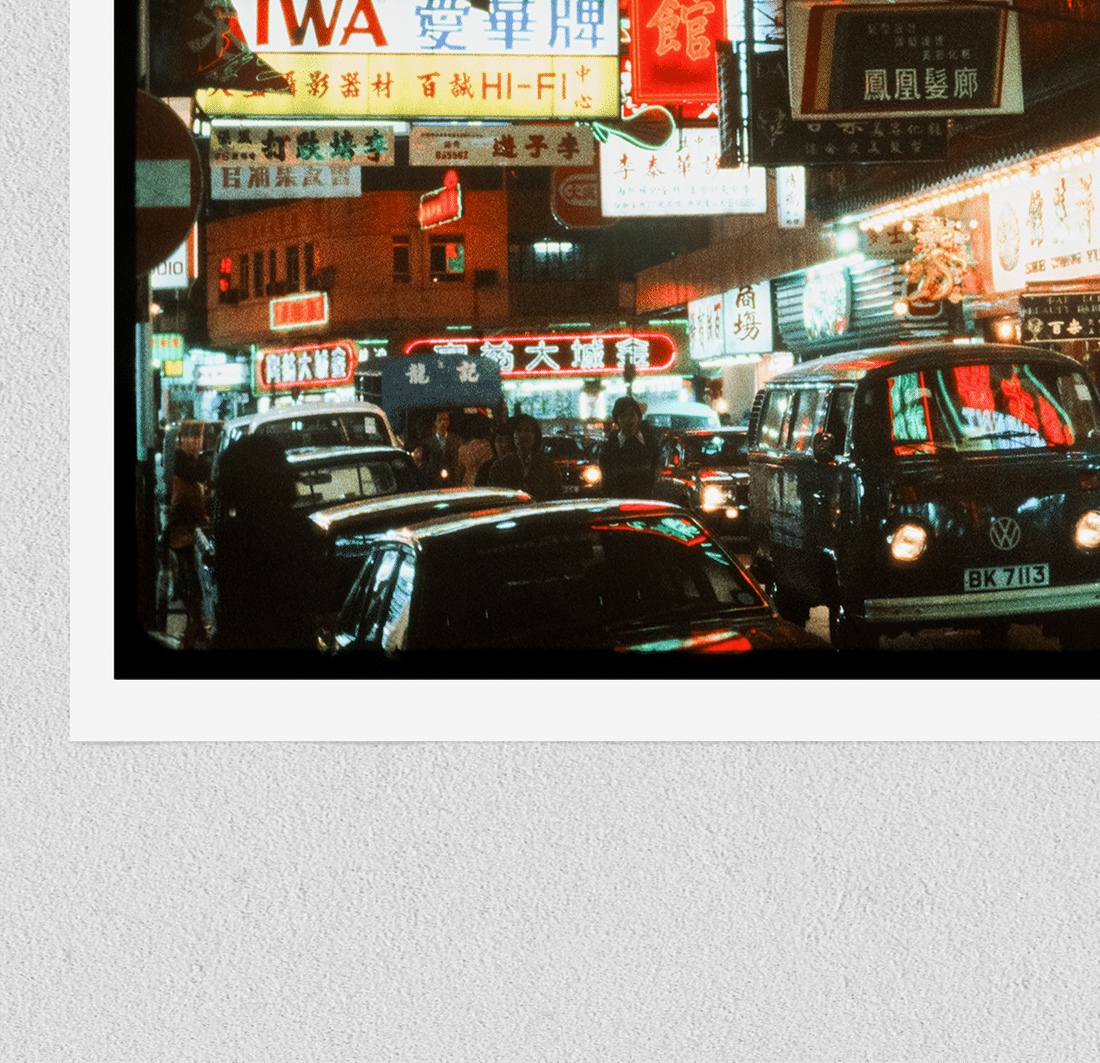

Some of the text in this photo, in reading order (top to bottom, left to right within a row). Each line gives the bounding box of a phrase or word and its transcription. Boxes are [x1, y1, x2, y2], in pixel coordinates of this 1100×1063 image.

[481, 71, 568, 100] HI-FI
[969, 564, 1046, 589] BK 7113
